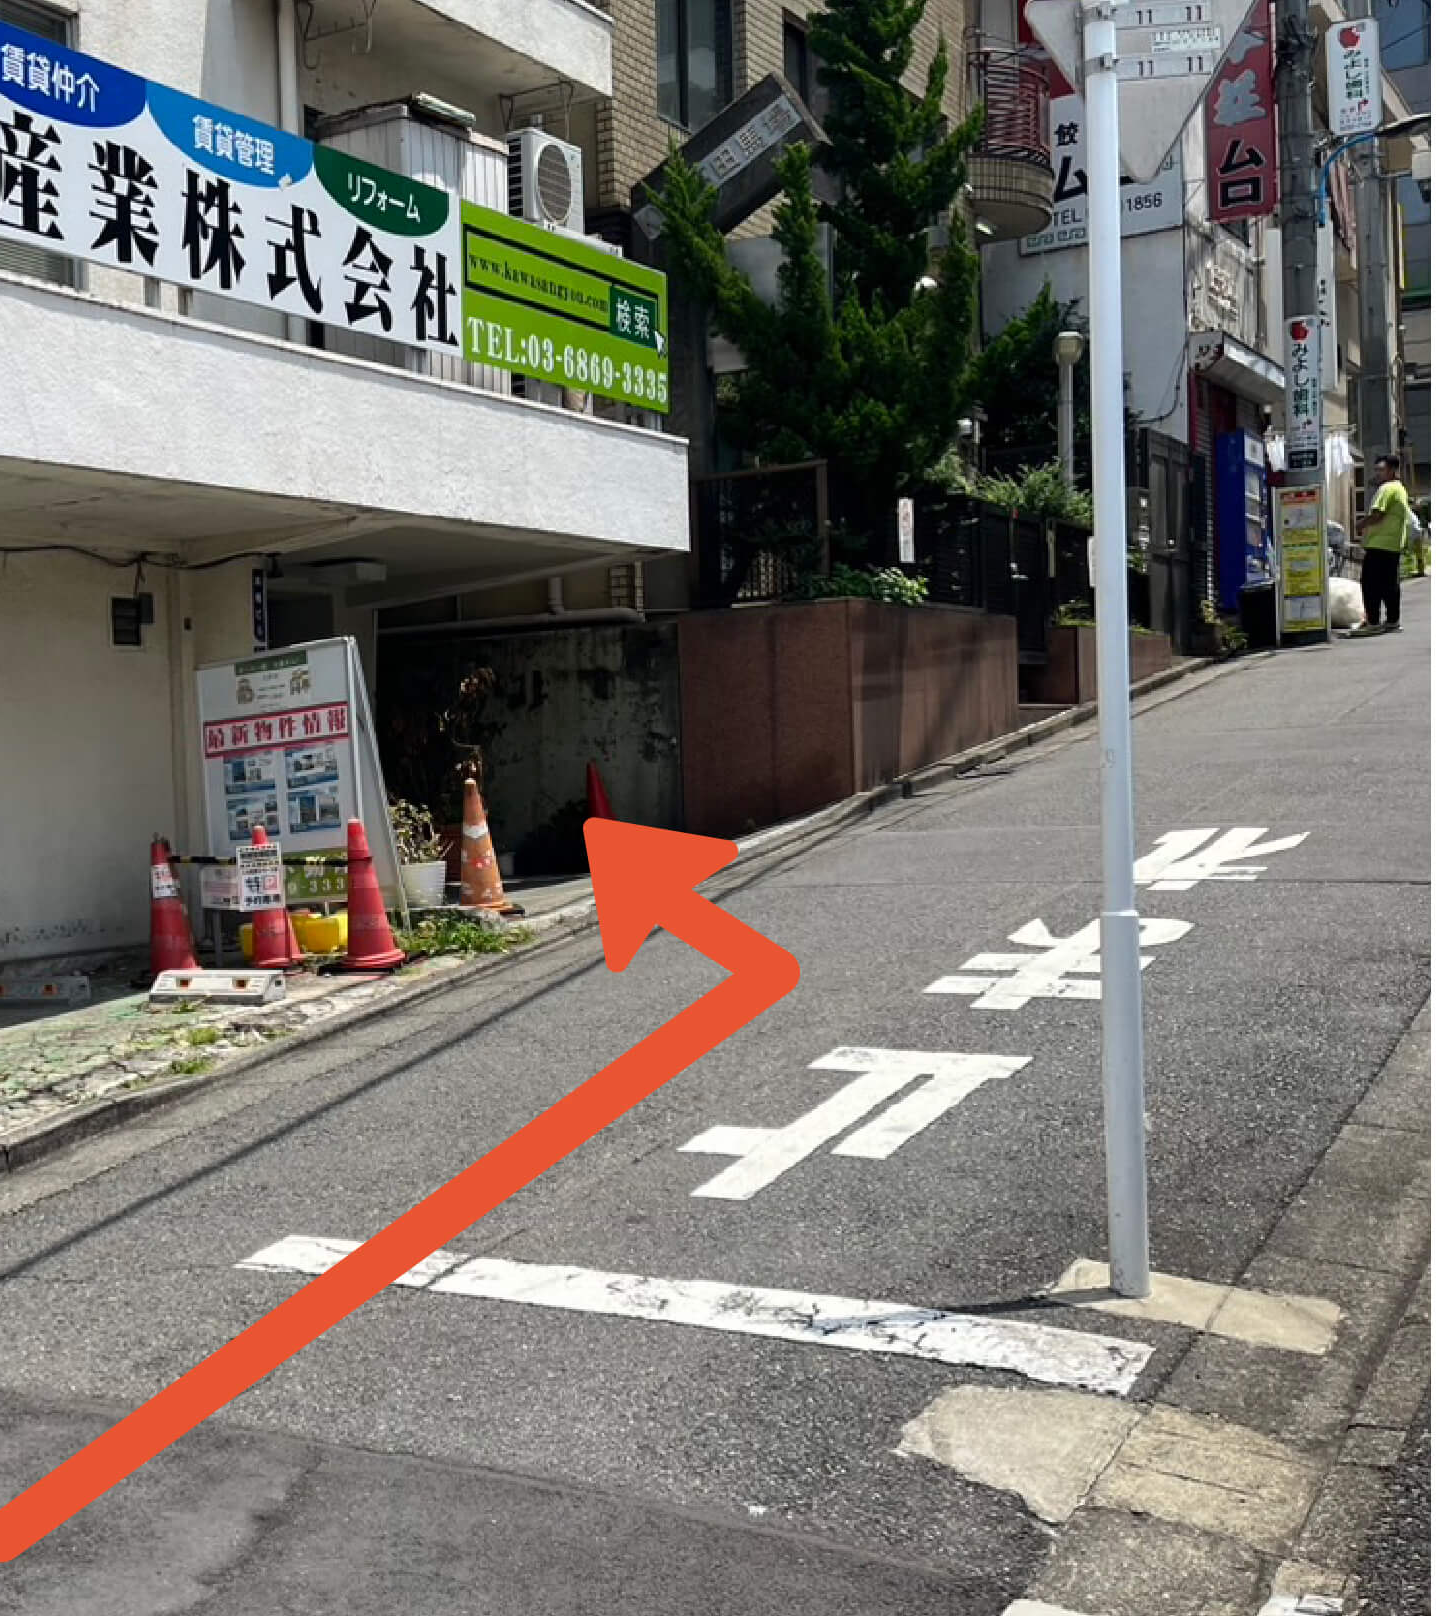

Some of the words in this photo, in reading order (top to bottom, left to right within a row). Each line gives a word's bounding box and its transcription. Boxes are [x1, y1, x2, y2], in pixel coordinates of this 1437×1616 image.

[0, 43, 100, 113] 賃貸仲介
[192, 114, 276, 176] 賃貸管理
[348, 172, 421, 223] リフォーム
[1054, 208, 1082, 226] TEL
[616, 298, 650, 340] 検索
[468, 316, 669, 403] TEL:03-6869-3335
[207, 707, 347, 750] 最新物件情報
